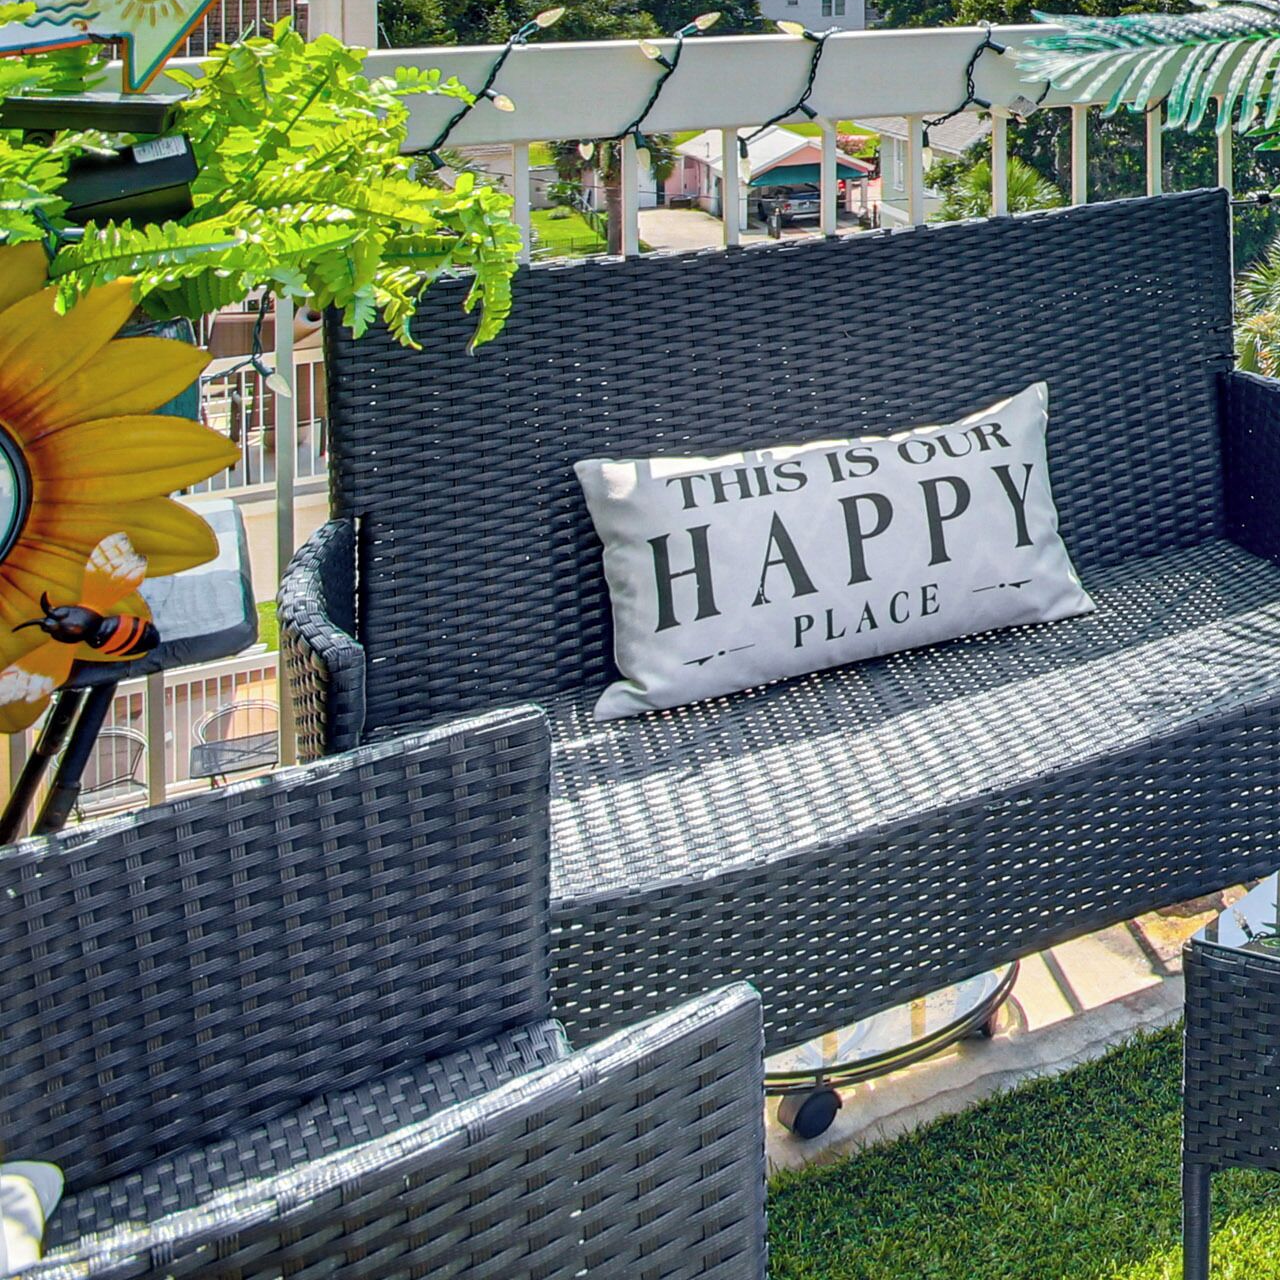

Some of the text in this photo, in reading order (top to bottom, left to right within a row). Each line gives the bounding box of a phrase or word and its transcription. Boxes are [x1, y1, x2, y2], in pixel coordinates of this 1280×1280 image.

[666, 422, 1012, 510] THIS IS OUR
[647, 462, 1034, 633] HAPPY
[792, 582, 942, 648] PLACE
